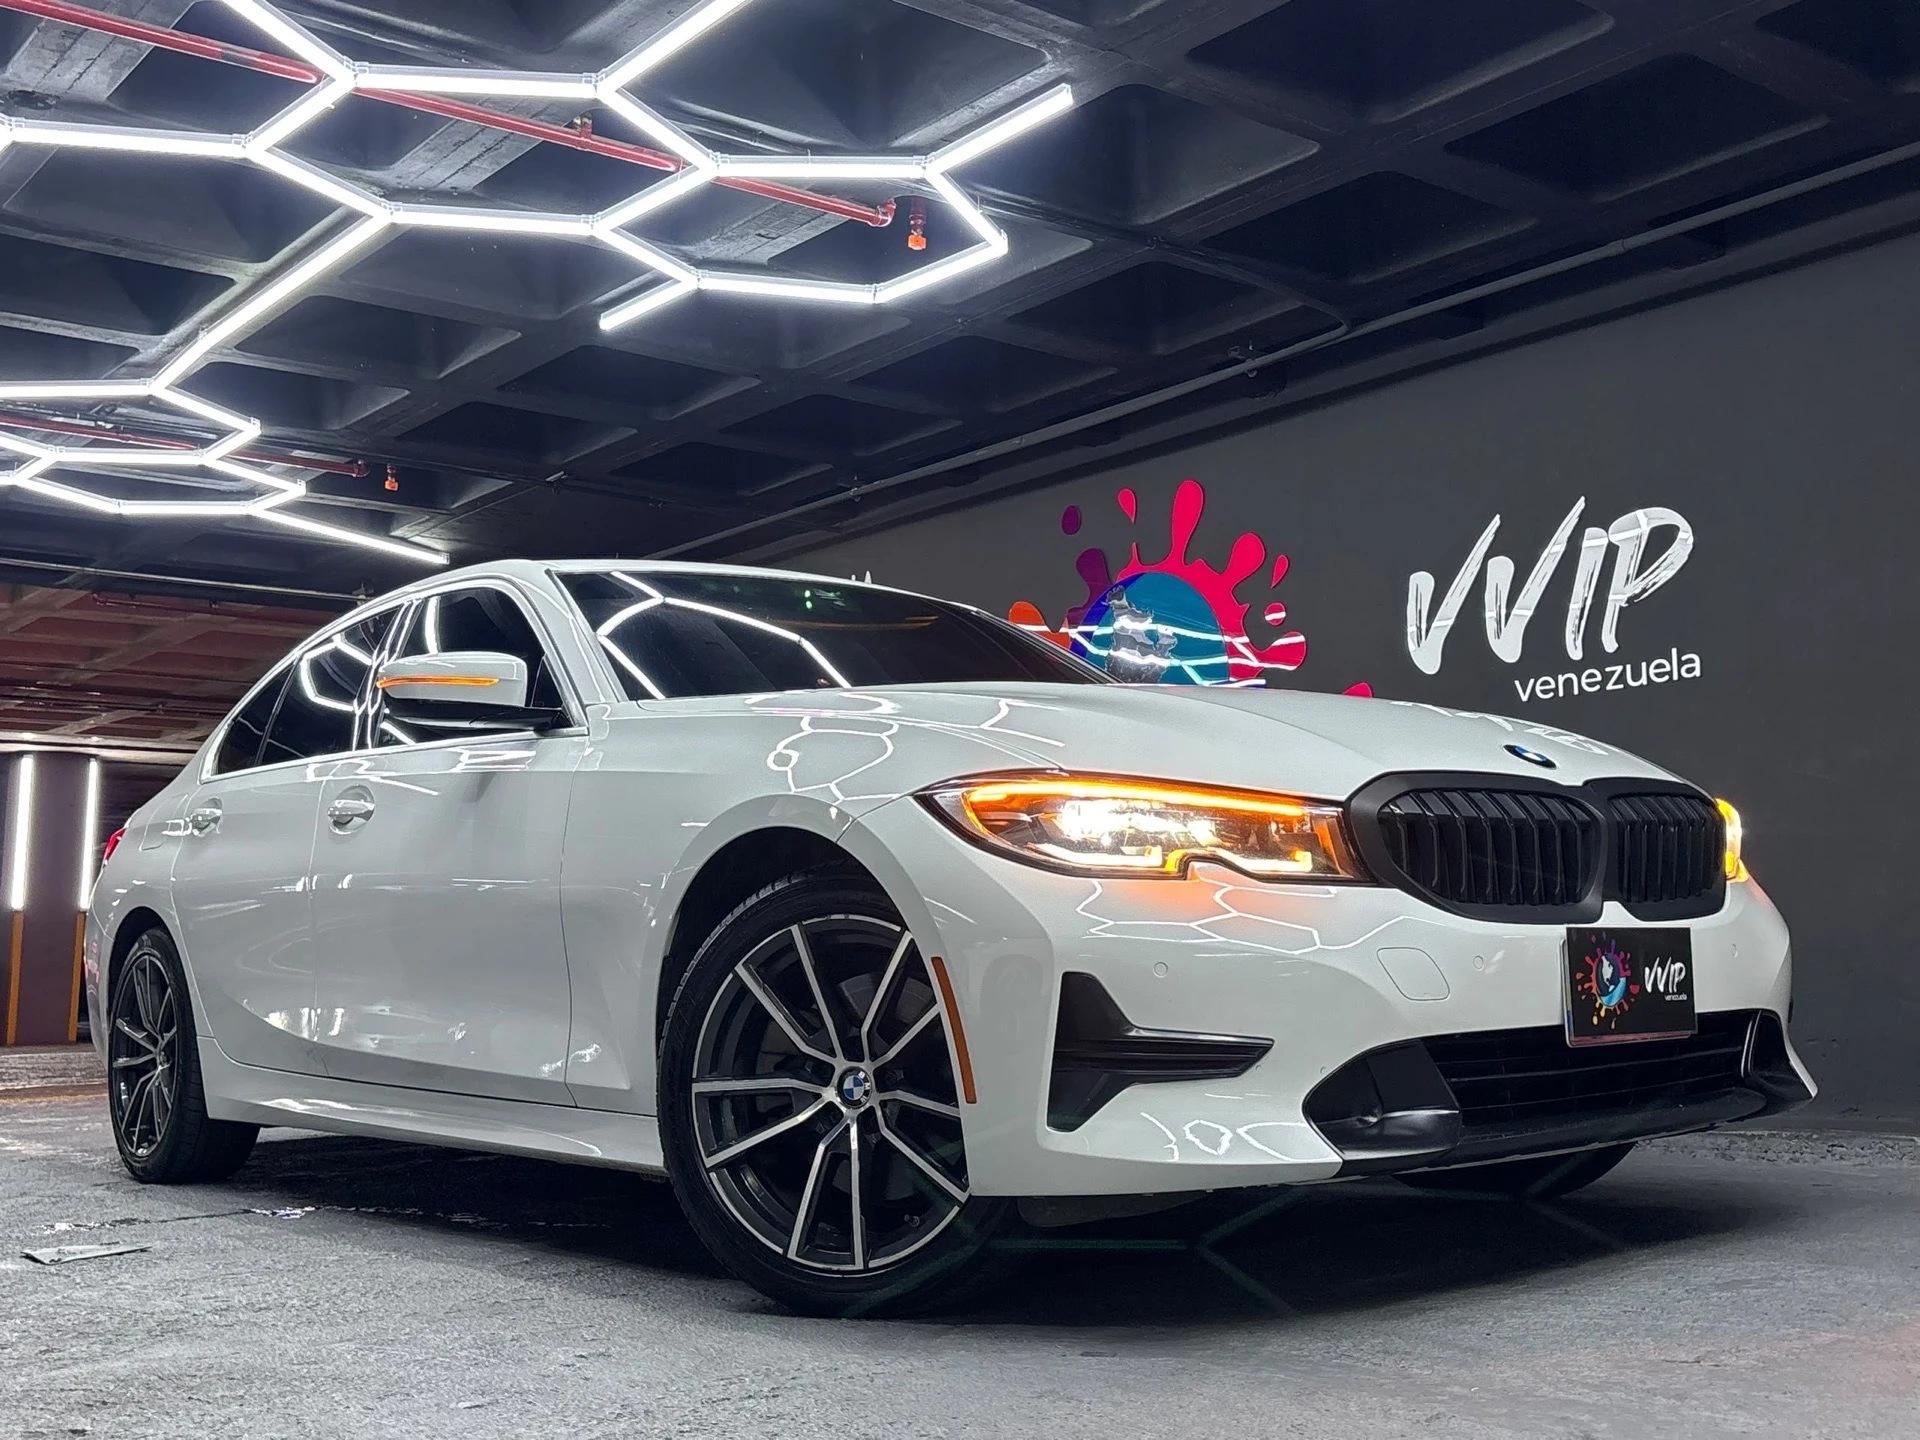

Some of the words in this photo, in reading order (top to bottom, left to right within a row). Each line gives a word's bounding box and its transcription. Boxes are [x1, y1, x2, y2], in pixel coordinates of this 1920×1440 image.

[1407, 496, 1694, 675] VVIP
[1514, 647, 1702, 702] venezuela
[1644, 956, 1686, 993] VVIP
